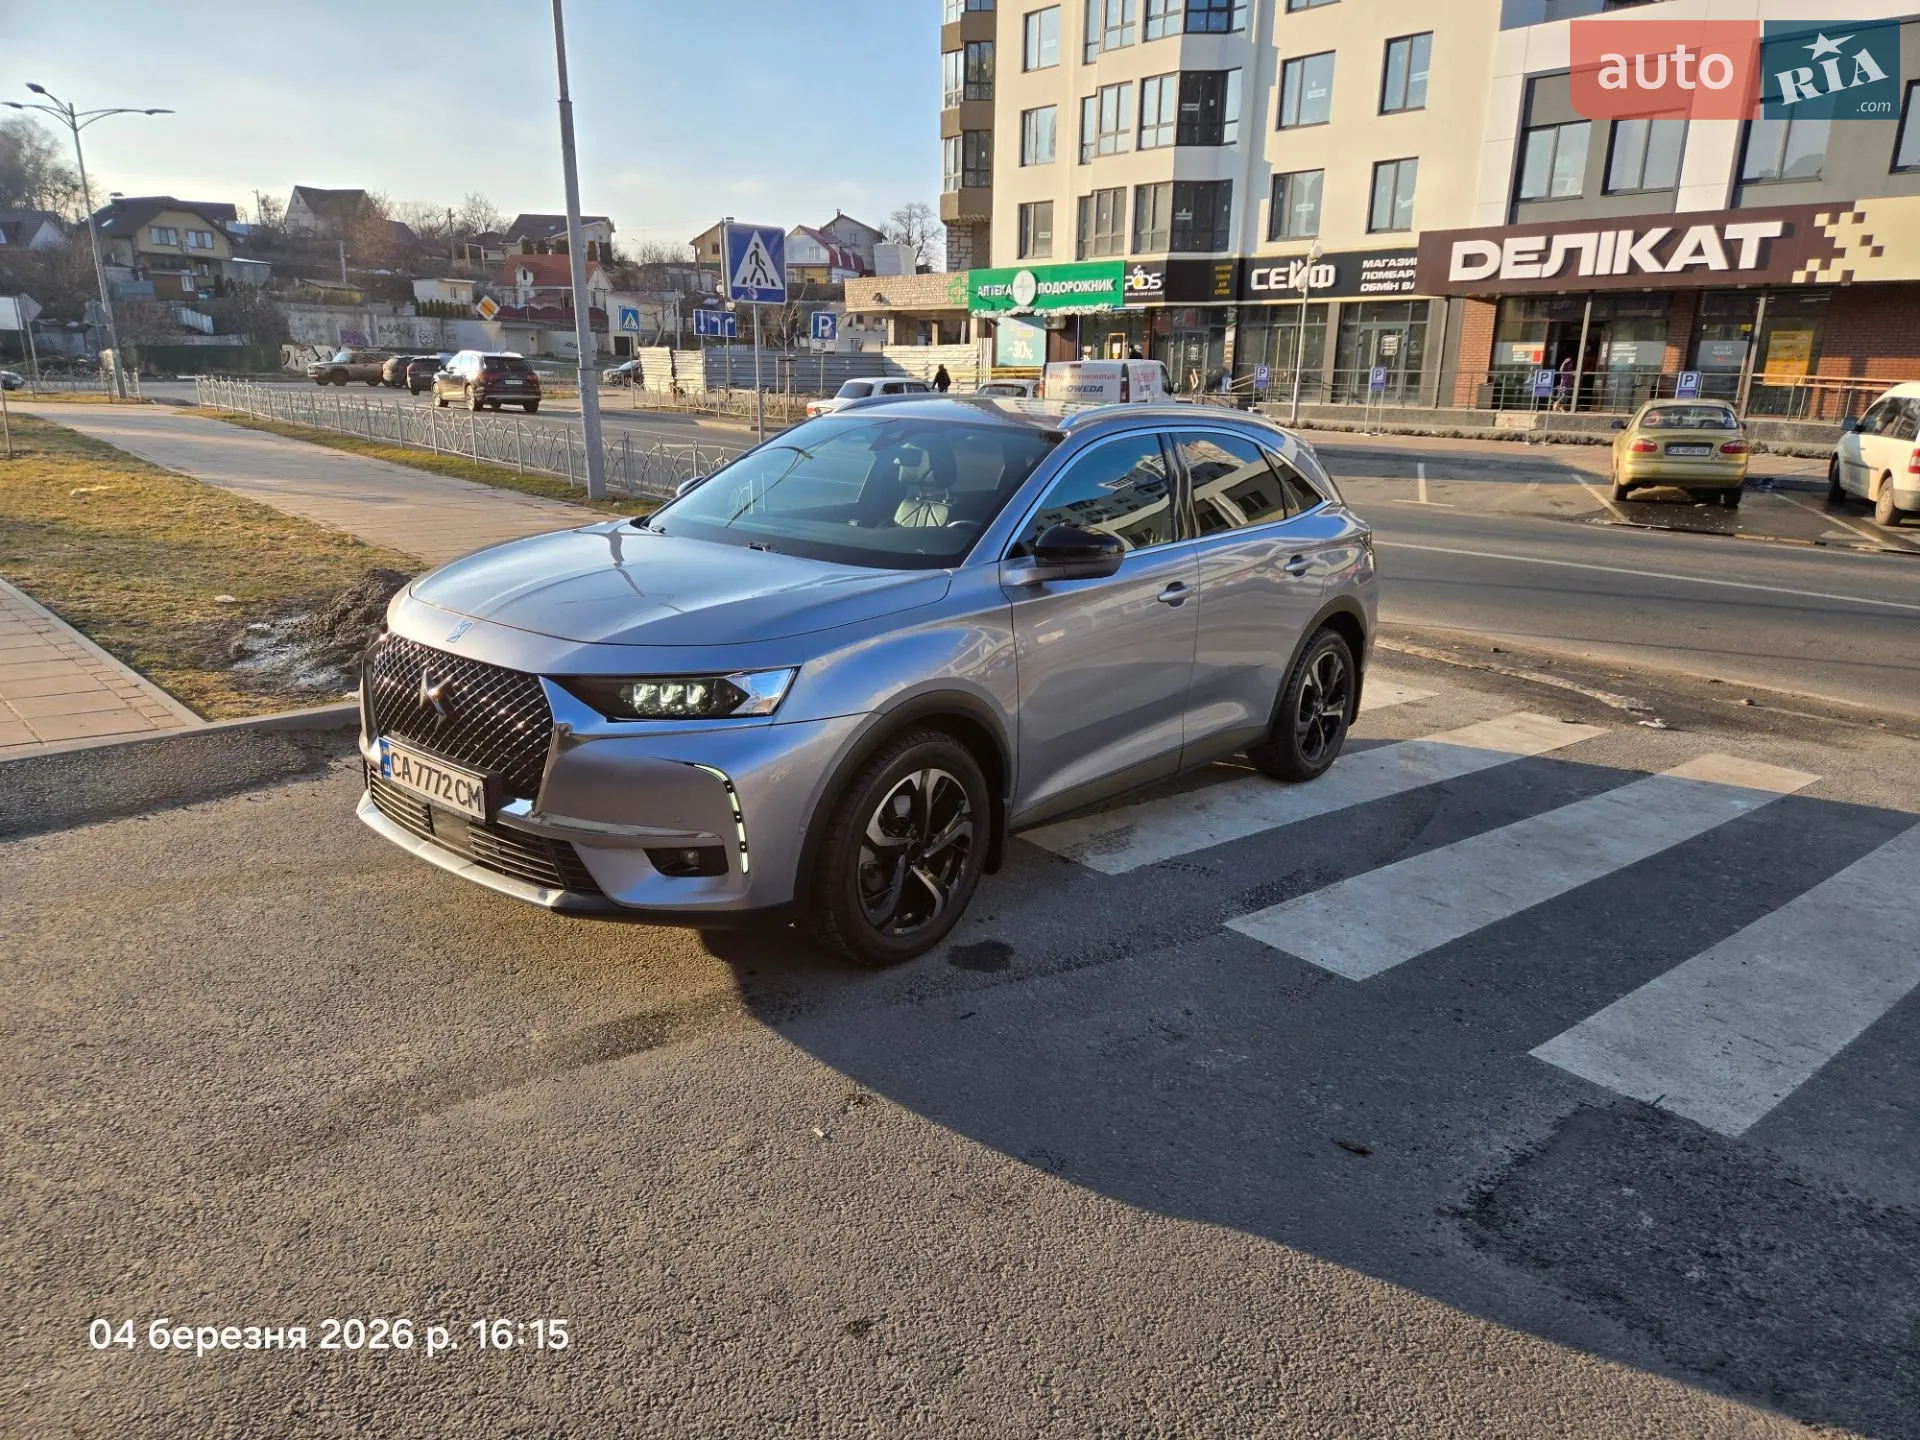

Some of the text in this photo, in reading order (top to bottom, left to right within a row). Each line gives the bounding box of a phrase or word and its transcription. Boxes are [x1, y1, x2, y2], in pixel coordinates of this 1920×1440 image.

[1250, 259, 1336, 291] СЕЙФ
[1361, 269, 1417, 280] ЛОМБАР
[977, 278, 1115, 297] АПТЕКА ПОДОРОЖНИК
[1360, 280, 1400, 292] ОБМІН
[1540, 372, 1549, 382] P
[1684, 374, 1694, 386] P
[390, 751, 482, 813] CA 7772 CM
